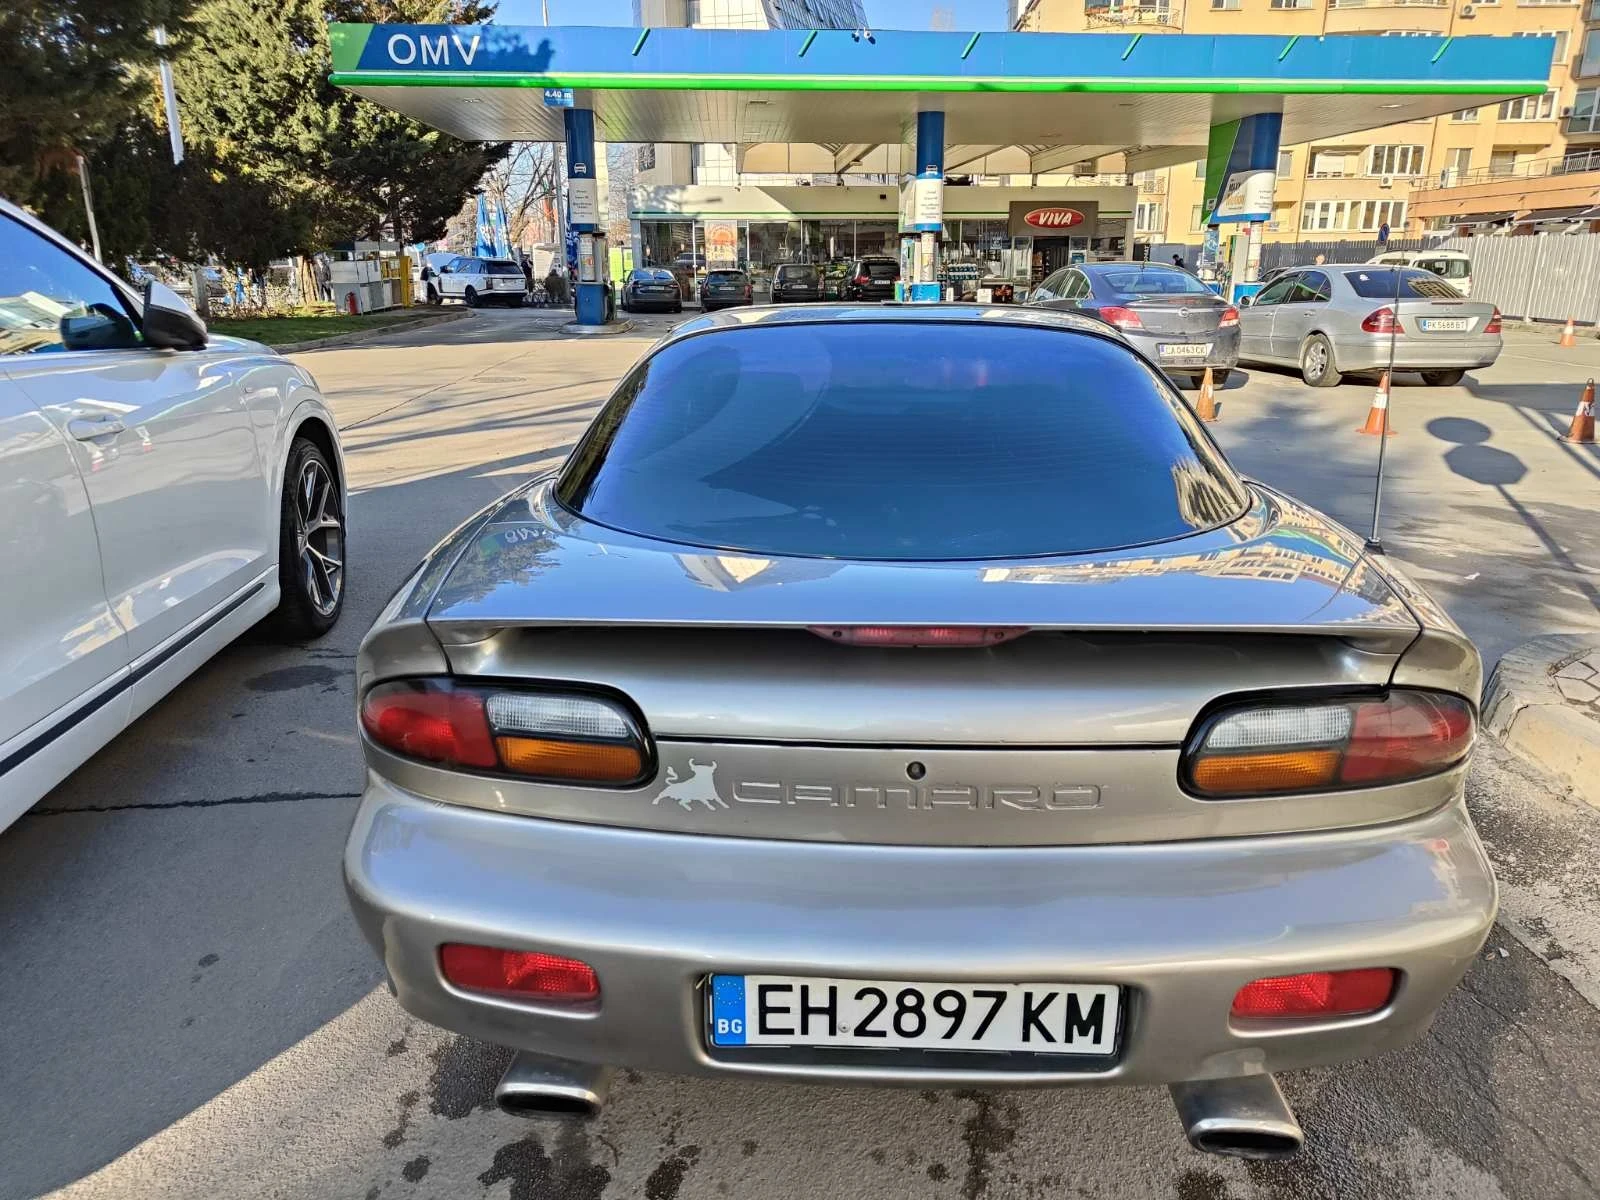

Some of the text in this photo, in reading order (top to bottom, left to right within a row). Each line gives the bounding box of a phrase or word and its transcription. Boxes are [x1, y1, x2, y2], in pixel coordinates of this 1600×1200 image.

[387, 33, 481, 66] OMV
[545, 90, 562, 98] 4.40
[1038, 212, 1072, 226] VIVA
[733, 781, 1104, 811] CAMARO
[717, 1018, 743, 1034] BG
[757, 984, 1107, 1045] EH 2897 KM
